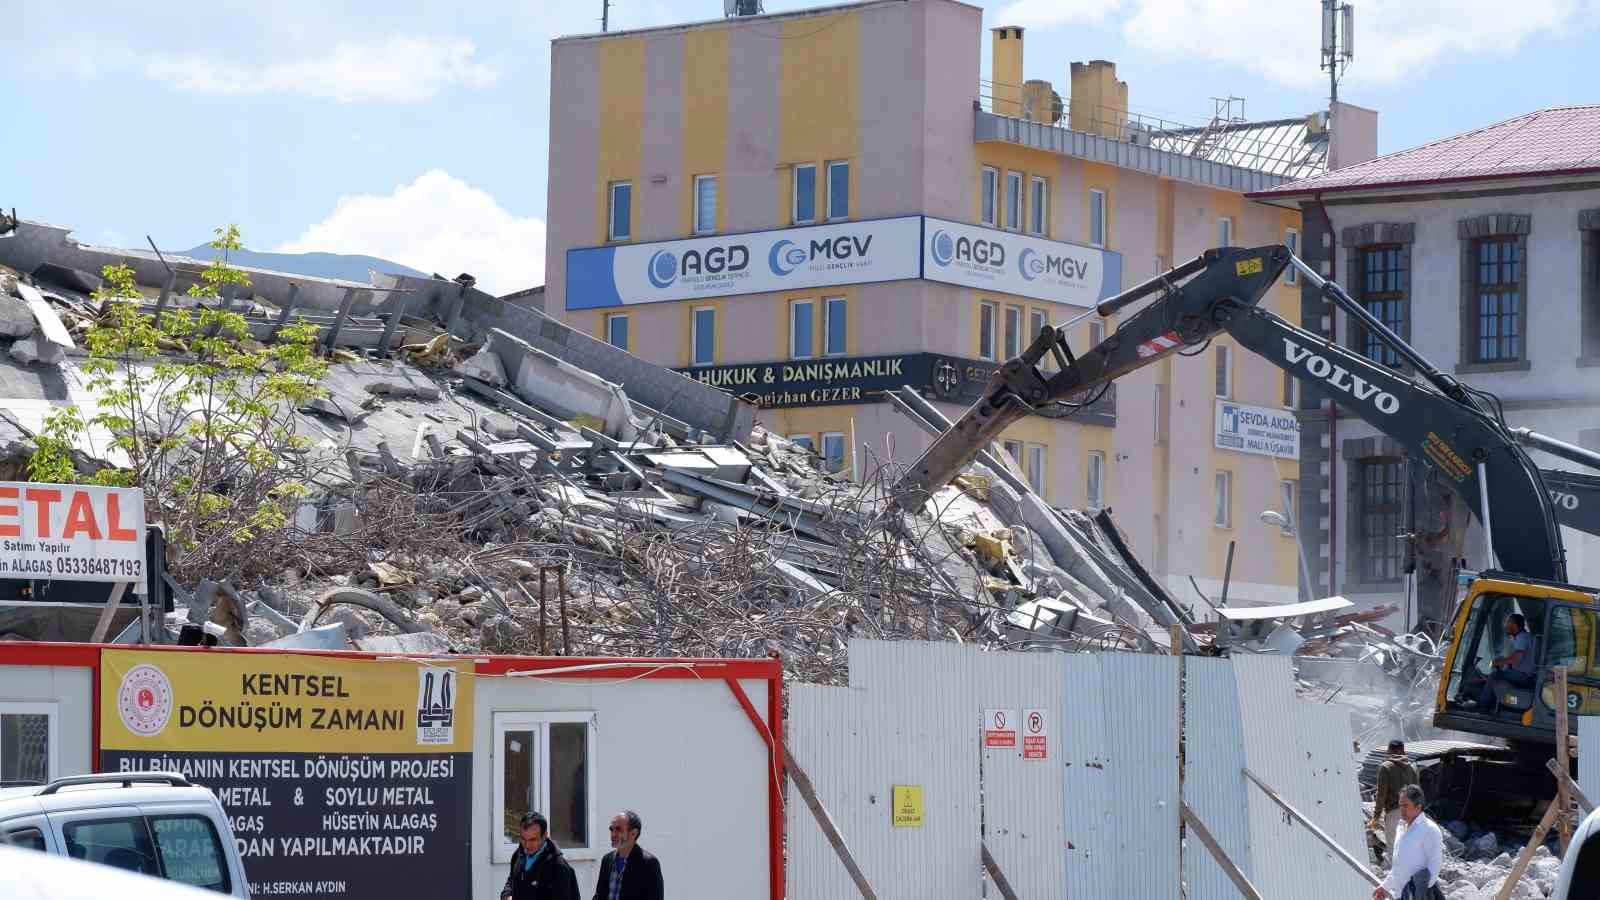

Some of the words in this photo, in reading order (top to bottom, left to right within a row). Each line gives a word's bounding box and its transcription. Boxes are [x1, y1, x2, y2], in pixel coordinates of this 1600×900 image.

[681, 244, 750, 275] AGD
[809, 234, 873, 261] MGV
[956, 236, 1005, 267] AGD
[1046, 254, 1088, 280] MGV
[699, 367, 757, 386] HUKUK
[763, 366, 775, 384] &
[783, 358, 903, 385] DANIŞMANLIK
[1282, 337, 1400, 415] VOLVO
[811, 386, 861, 401] GEZER
[4, 540, 36, 552] Satımı
[39, 541, 71, 554] Yapılır
[12, 559, 53, 575] ALAGAŞ
[57, 557, 141, 576] 05336487193
[242, 673, 349, 697] KENTSEL
[179, 700, 301, 732] DÖNÜŞÜM
[310, 708, 404, 731] ZAMANI
[149, 753, 223, 778] BİNANIN
[229, 759, 300, 778] KENTSEL
[304, 755, 385, 782] DÖNÜŞÜM
[390, 755, 454, 778] PROJESİ
[218, 787, 271, 806] METAL
[294, 787, 304, 806] &
[326, 786, 378, 806] SOYLU
[382, 786, 434, 806] METAL
[322, 811, 379, 831] HÜSEYİN
[383, 813, 437, 832] ALAGAŞ
[280, 836, 425, 857] YAPILMAKTADIR
[263, 881, 313, 894] H.SERKAN
[315, 881, 346, 893] AYDIN
